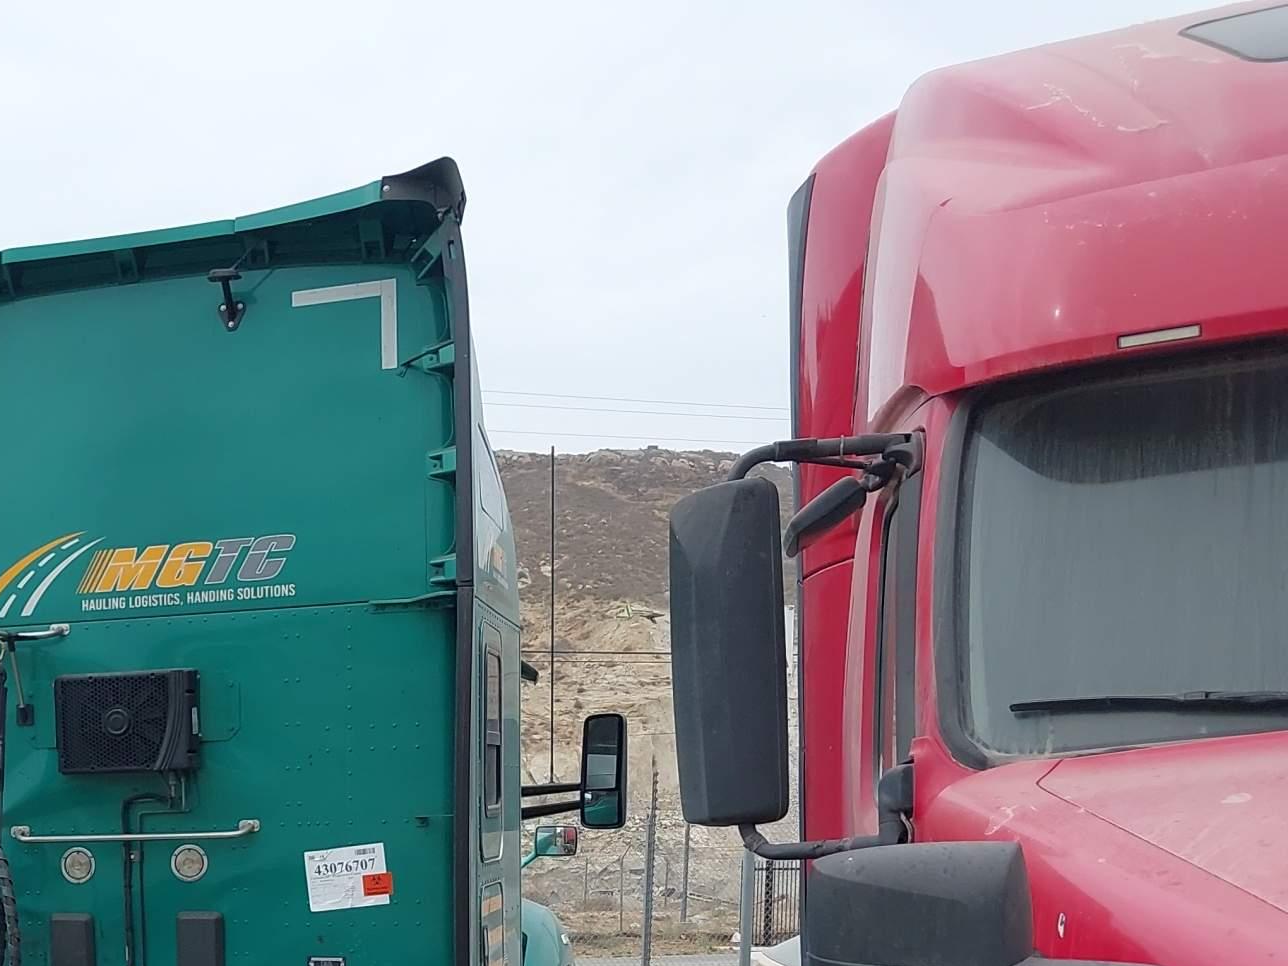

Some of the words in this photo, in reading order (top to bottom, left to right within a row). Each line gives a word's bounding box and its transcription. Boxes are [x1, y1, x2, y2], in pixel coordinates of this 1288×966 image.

[96, 534, 296, 592] MGTC
[82, 597, 126, 611] HAULING
[129, 593, 183, 608] LOGISTICS,
[187, 589, 235, 605] HANDING
[237, 584, 296, 600] SOLUTIONS
[314, 857, 376, 876] 43076707
